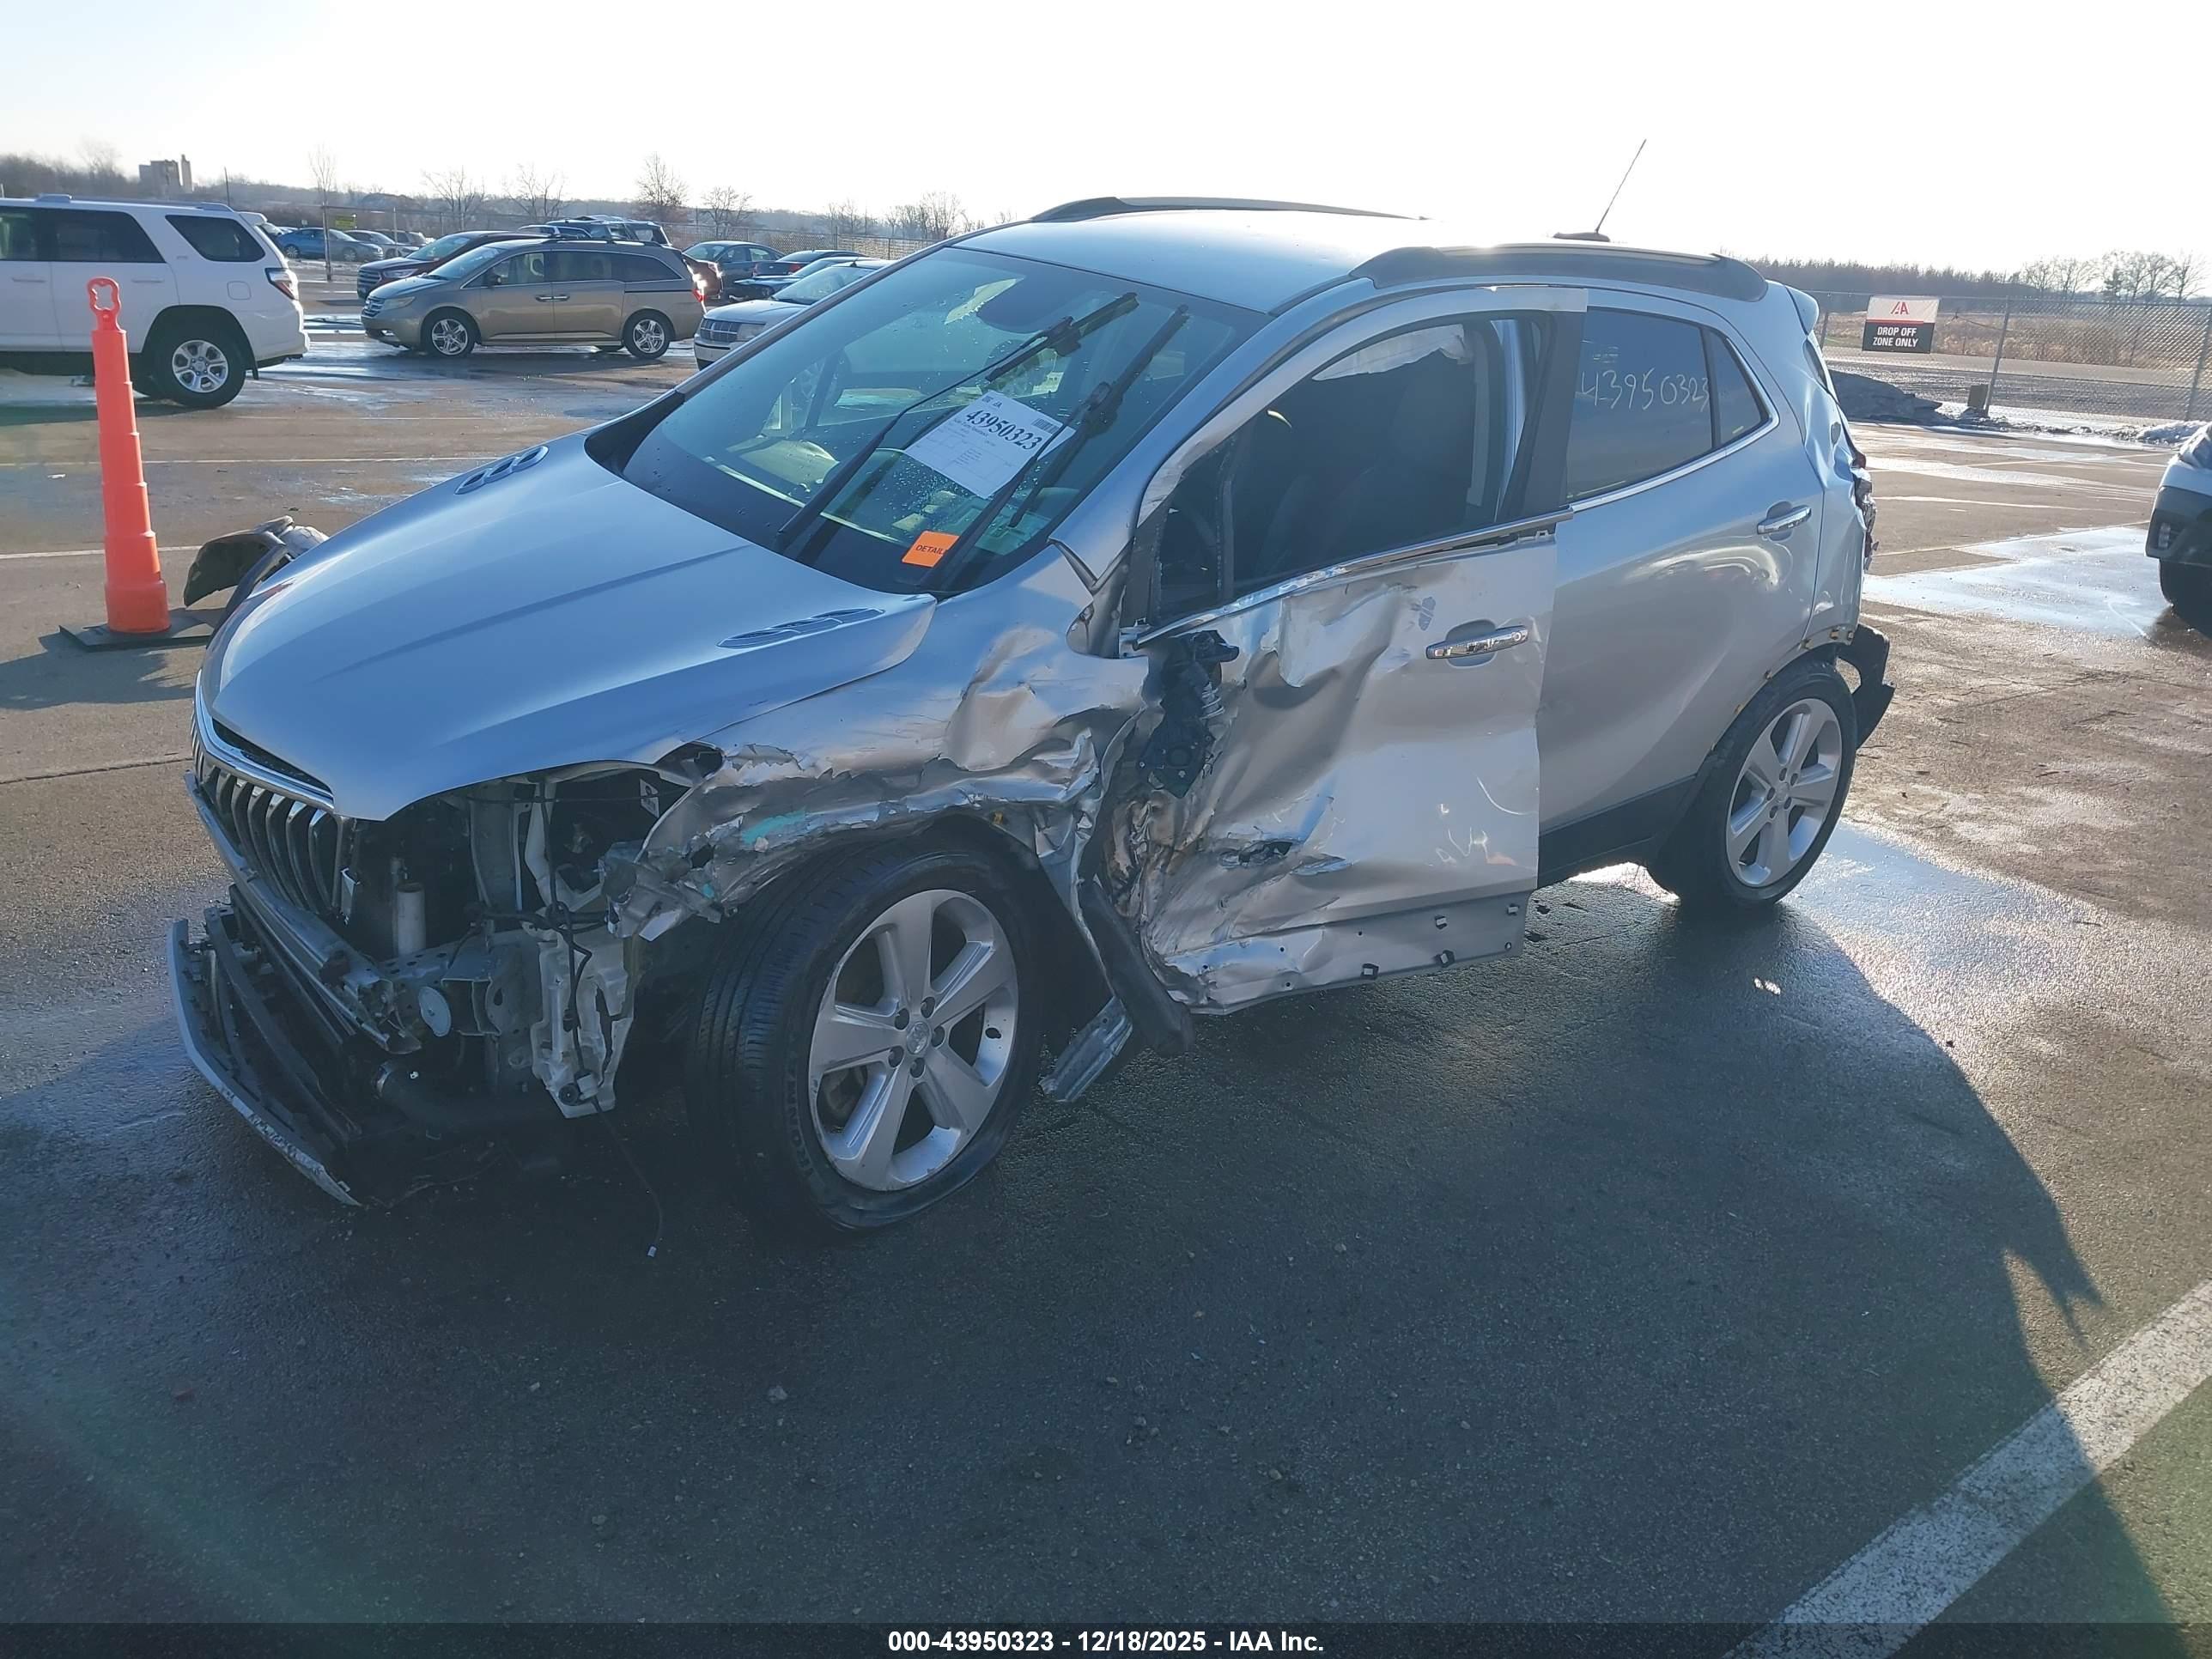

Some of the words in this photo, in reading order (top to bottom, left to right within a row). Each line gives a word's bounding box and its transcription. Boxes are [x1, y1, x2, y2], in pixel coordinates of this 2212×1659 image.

[1877, 326, 1899, 336] DROP
[1901, 327, 1917, 337] OFF
[1873, 337, 1893, 346] ZONE
[1895, 337, 1918, 347] ONLY
[1581, 368, 1710, 412] 43950323
[966, 410, 1043, 450] 43950323
[915, 544, 944, 555] DETAIL
